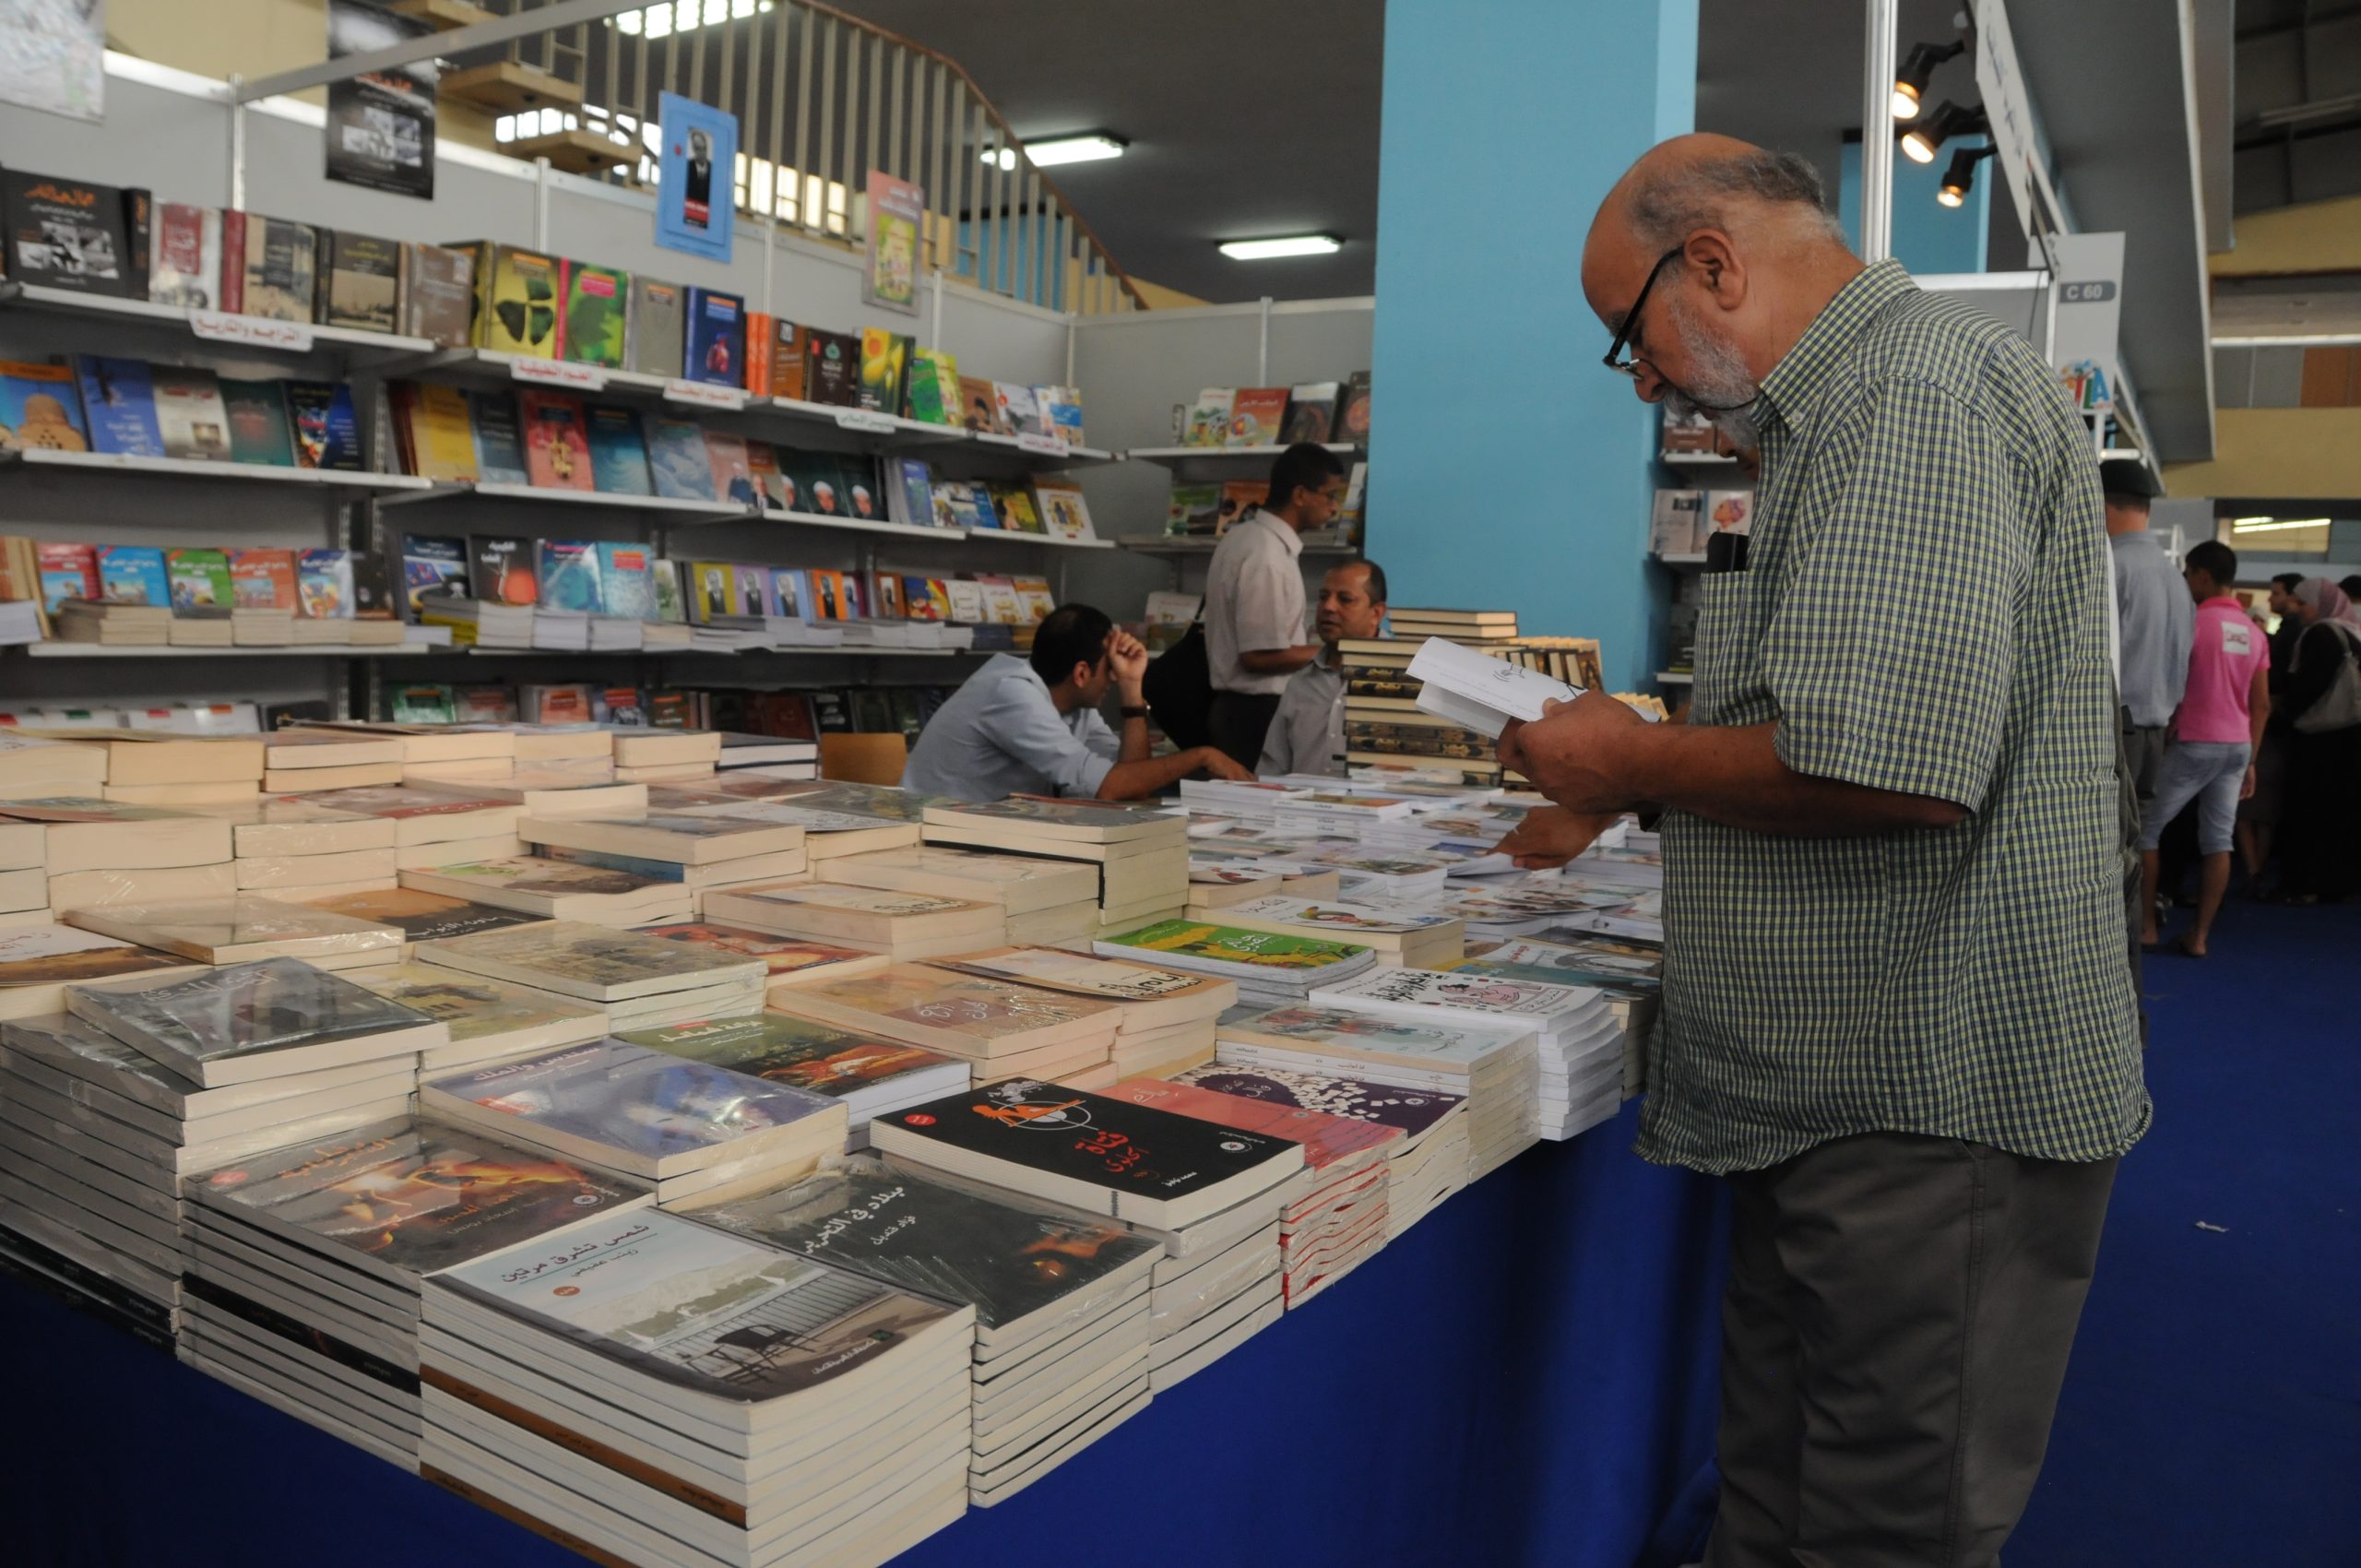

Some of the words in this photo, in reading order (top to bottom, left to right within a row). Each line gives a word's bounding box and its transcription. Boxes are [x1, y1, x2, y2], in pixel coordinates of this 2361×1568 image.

[2066, 286, 2079, 300] C
[2083, 284, 2103, 299] 60
[1074, 1130, 1129, 1154] فتاة
[868, 1187, 905, 1209] ميلاد
[844, 1209, 874, 1220] في
[605, 1225, 649, 1246] شمس
[804, 1218, 851, 1253] التحرير
[871, 1227, 898, 1245] قنديل
[550, 1243, 598, 1265] تشرق
[502, 1263, 547, 1282] مرتين
